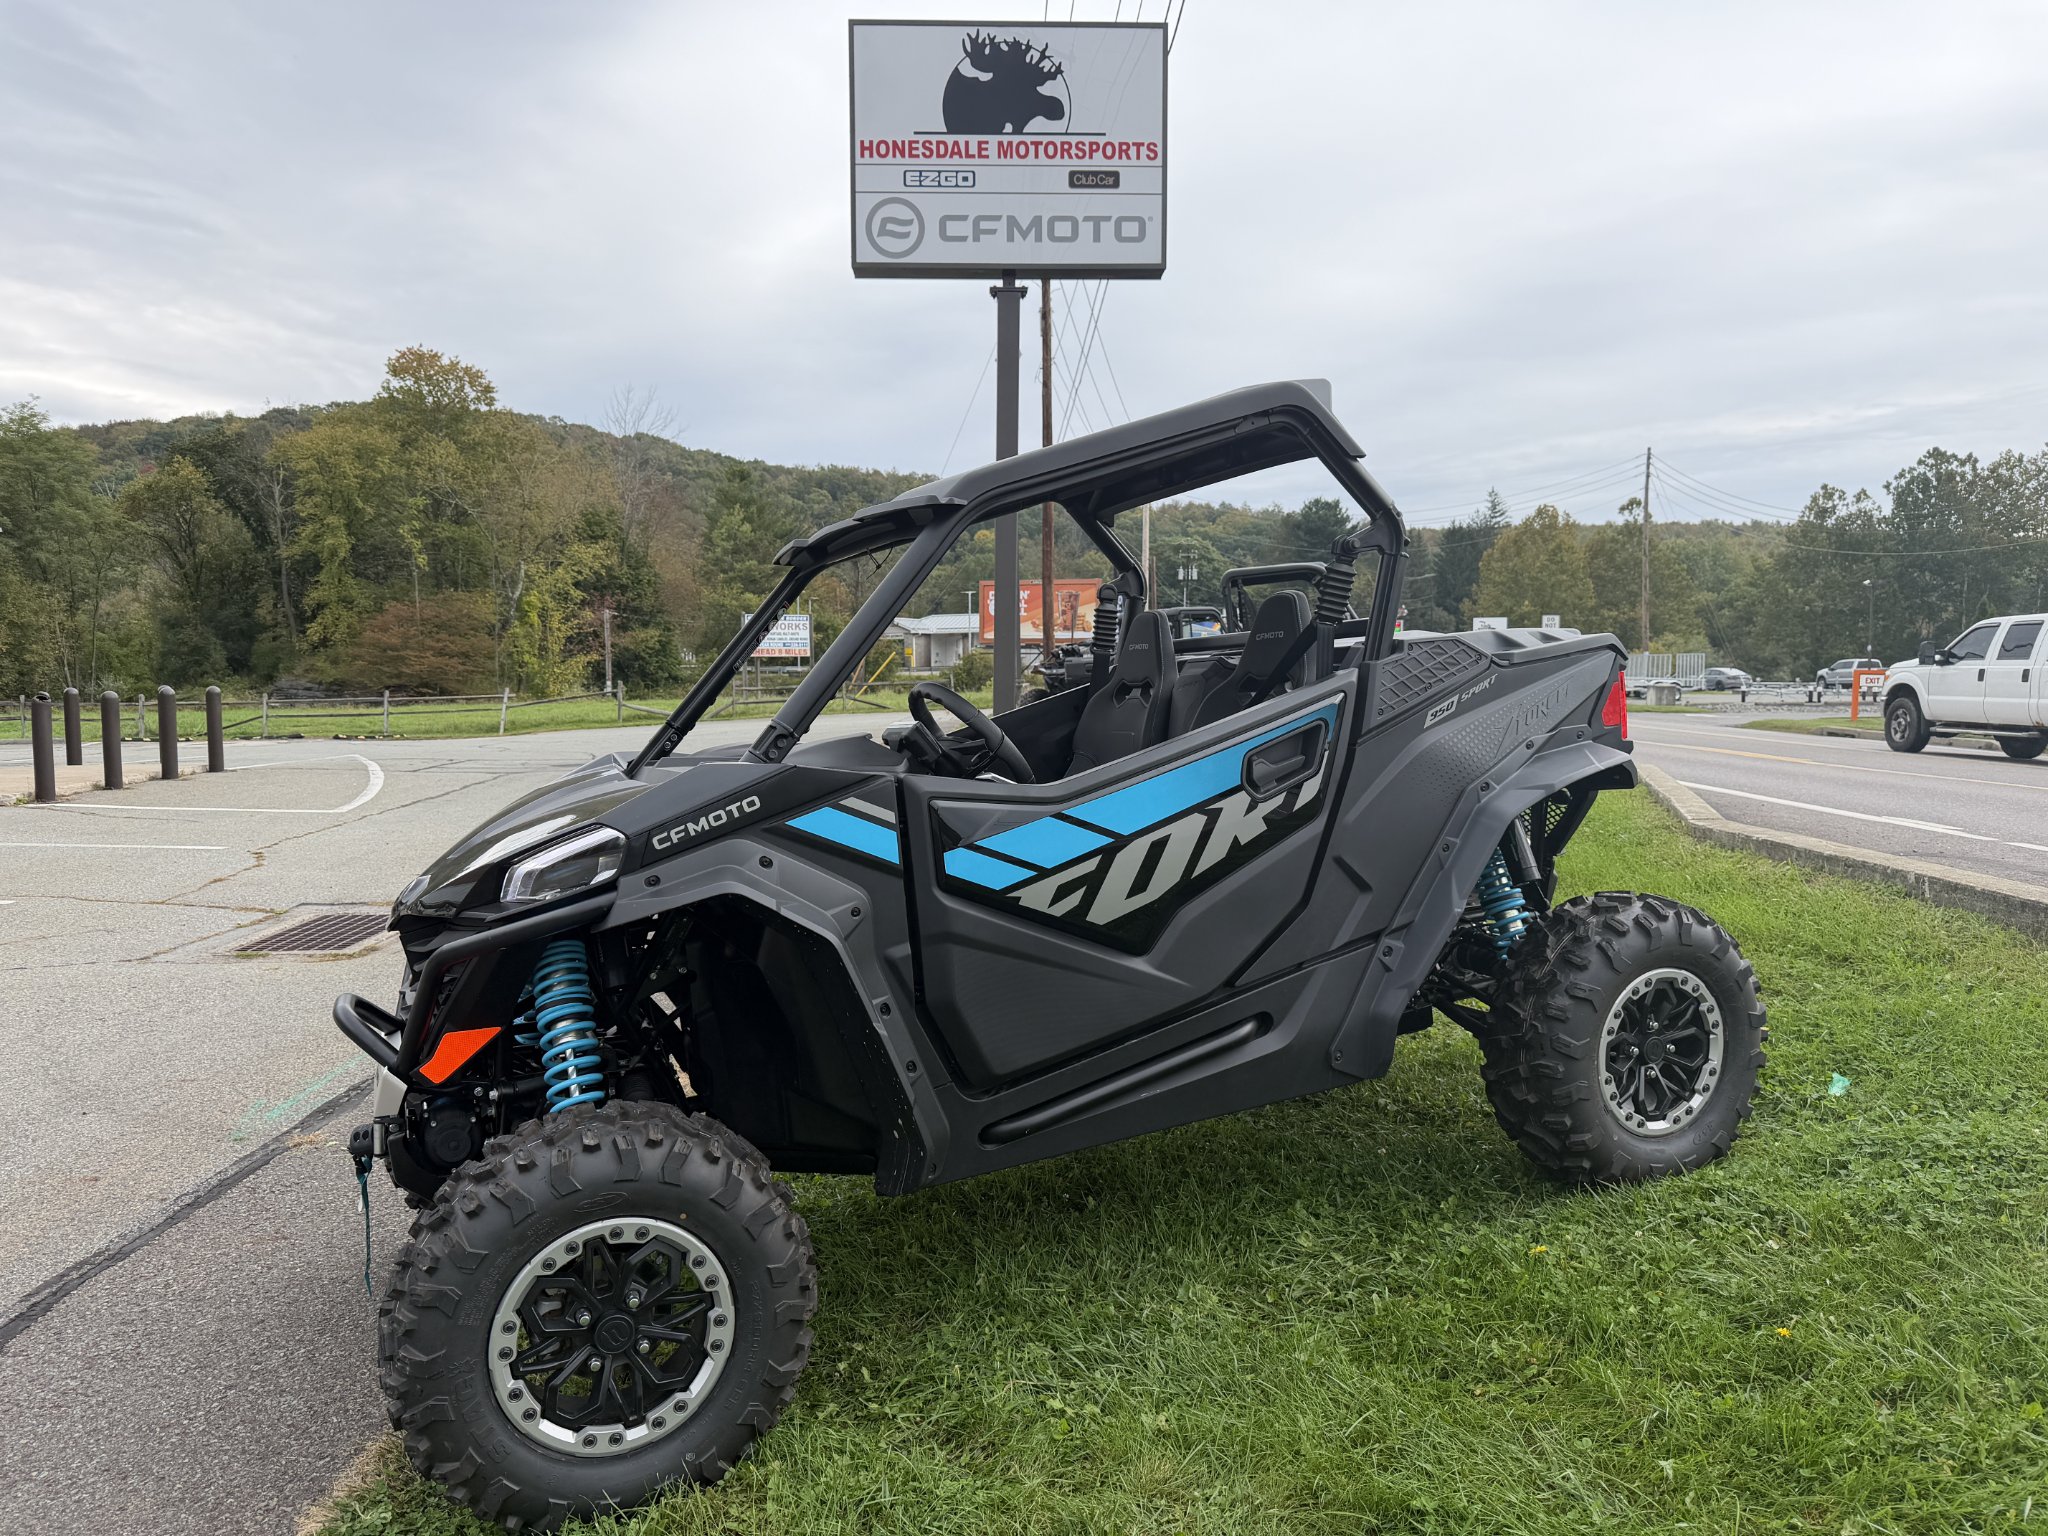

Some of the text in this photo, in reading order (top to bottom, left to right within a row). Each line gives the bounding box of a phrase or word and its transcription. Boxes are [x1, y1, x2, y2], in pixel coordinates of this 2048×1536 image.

[859, 139, 1158, 161] HONESDALE MOTORSPORTS
[904, 170, 975, 187] EZGO
[1073, 174, 1115, 186] Club Car
[938, 214, 1147, 243] CFMOTO
[1256, 631, 1284, 641] CFMOTO
[1865, 677, 1880, 685] EXIT
[1429, 673, 1498, 722] 950 SPORT
[652, 795, 761, 850] CFMOTO
